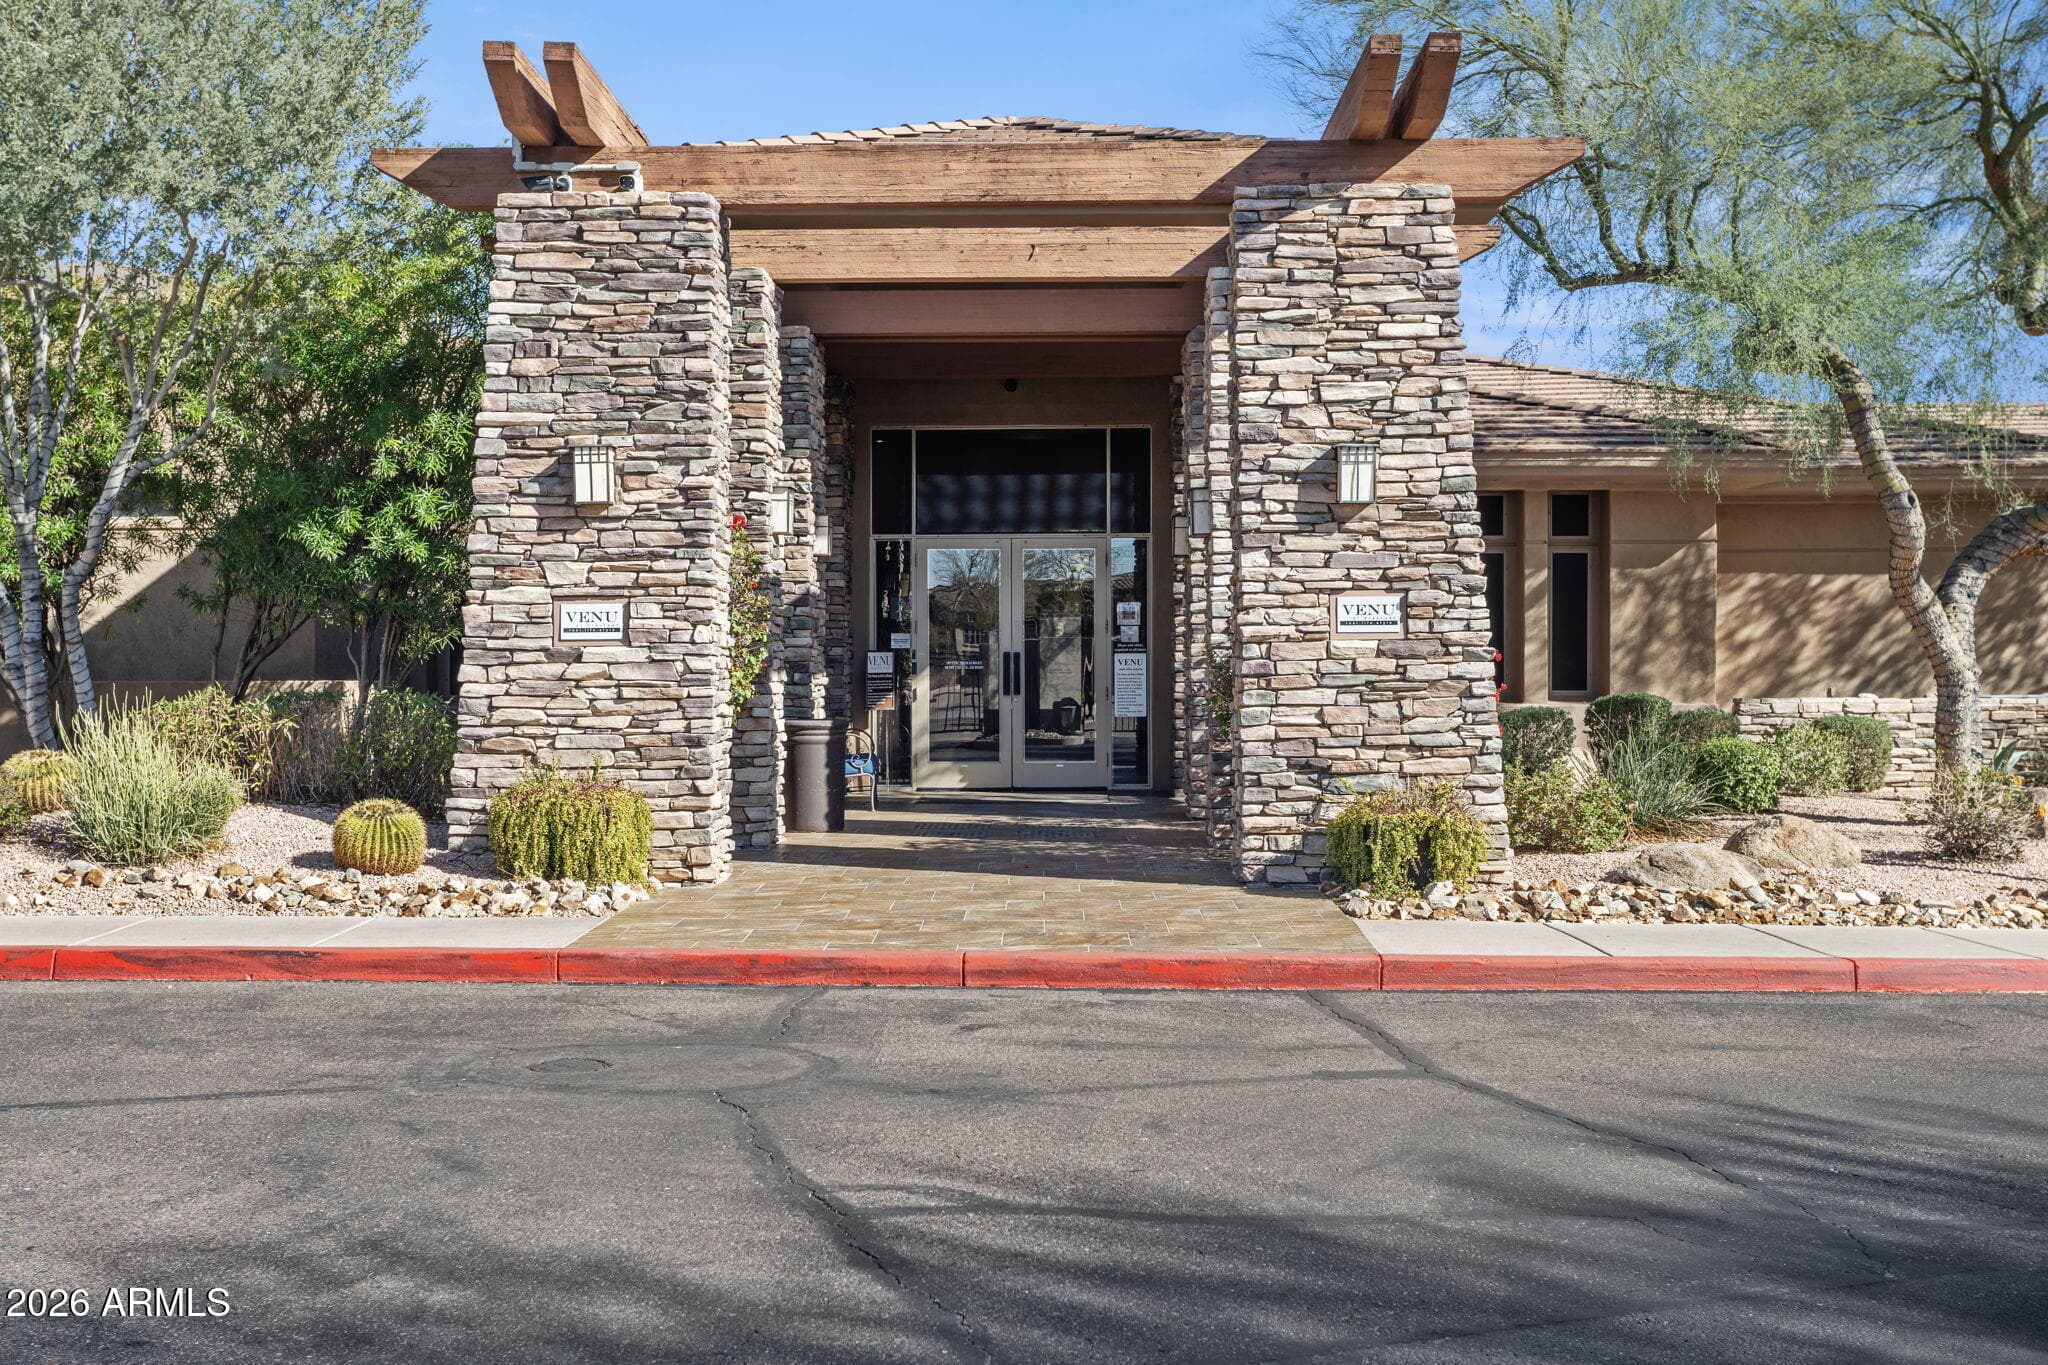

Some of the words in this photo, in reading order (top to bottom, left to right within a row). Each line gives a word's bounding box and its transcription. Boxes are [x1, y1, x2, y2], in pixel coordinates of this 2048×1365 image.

[1342, 604, 1395, 616] VENU
[566, 611, 618, 623] VENU
[1117, 658, 1144, 666] VENU
